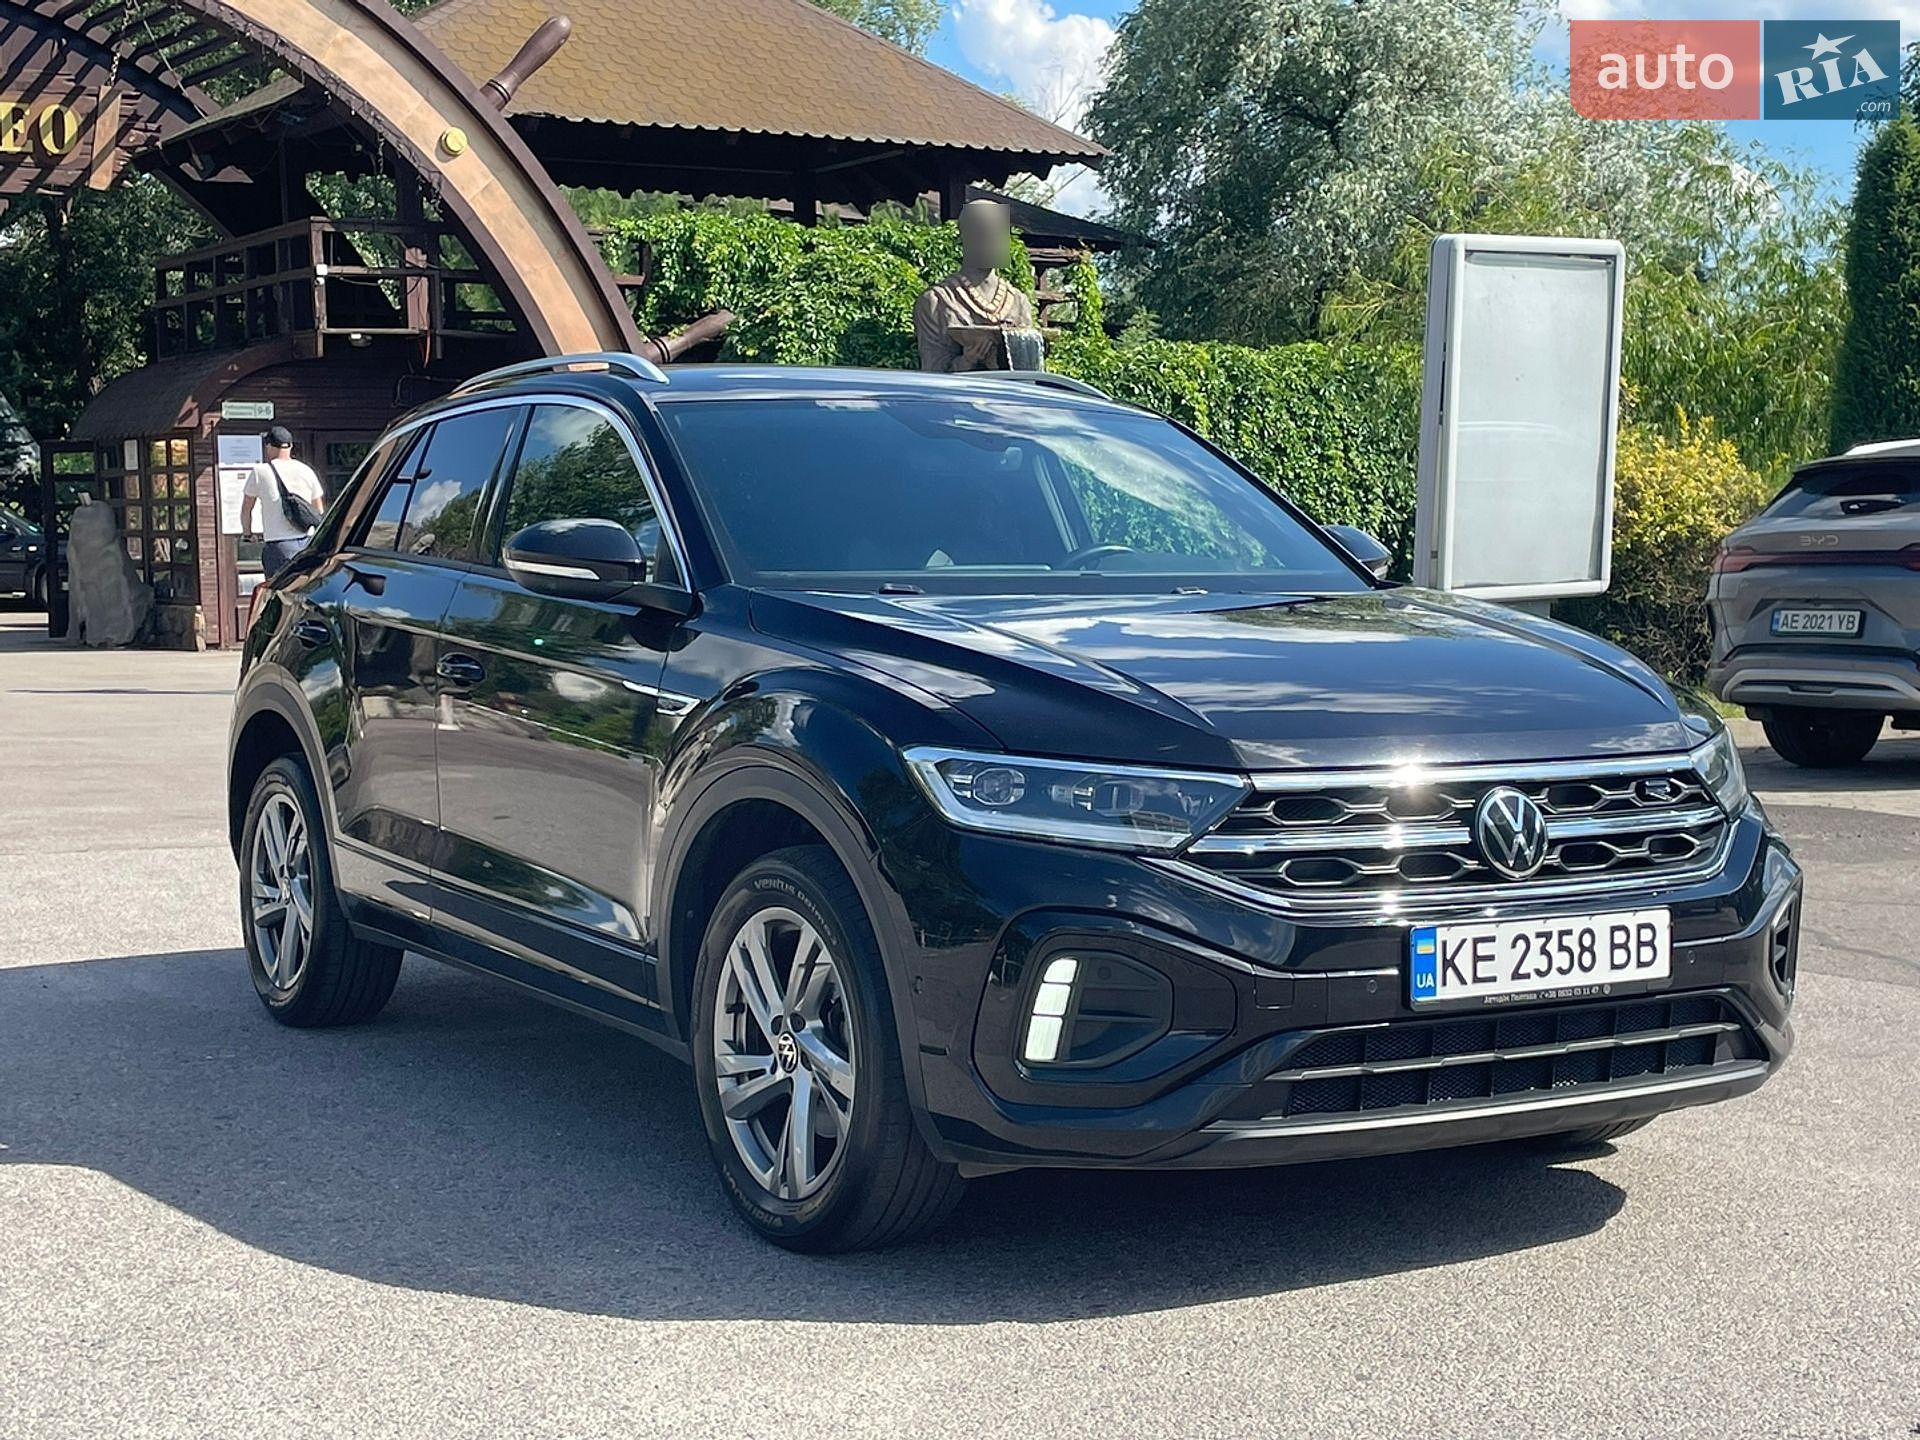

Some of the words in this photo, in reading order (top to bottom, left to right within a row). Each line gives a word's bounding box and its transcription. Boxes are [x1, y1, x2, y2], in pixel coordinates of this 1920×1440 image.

[1800, 535, 1839, 547] BYD
[1781, 613, 1800, 630] AE
[1802, 614, 1834, 630] 2021
[1838, 614, 1856, 631] YB
[1441, 935, 1497, 988] KE
[1510, 927, 1597, 981] 2358
[1609, 922, 1658, 971] BB
[1416, 972, 1435, 989] UA
